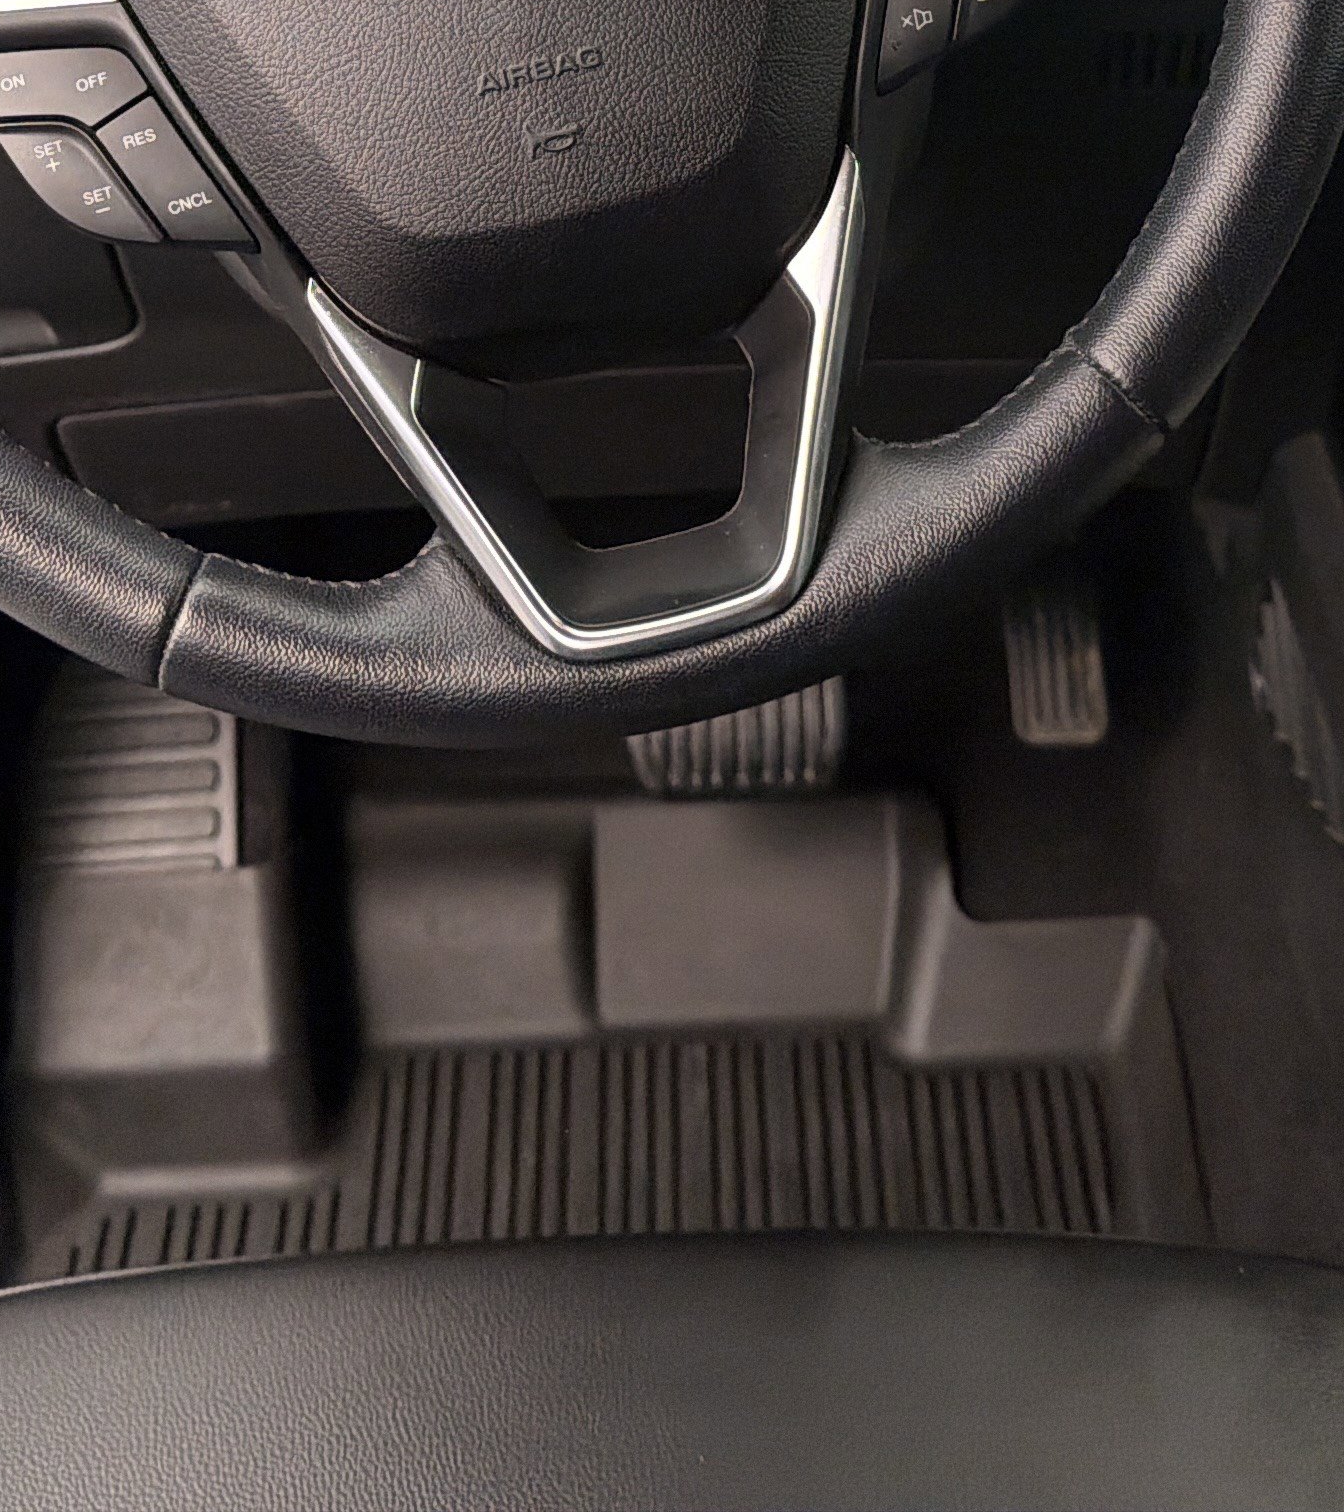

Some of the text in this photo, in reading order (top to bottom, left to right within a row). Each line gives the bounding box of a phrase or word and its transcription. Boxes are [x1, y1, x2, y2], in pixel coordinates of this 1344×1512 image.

[75, 71, 108, 92] OFF
[476, 46, 604, 97] AIRBAG
[0, 74, 26, 92] ON
[33, 140, 63, 159] SET
[122, 128, 157, 150] RES
[82, 186, 112, 206] SET
[167, 191, 213, 215] CNCL
